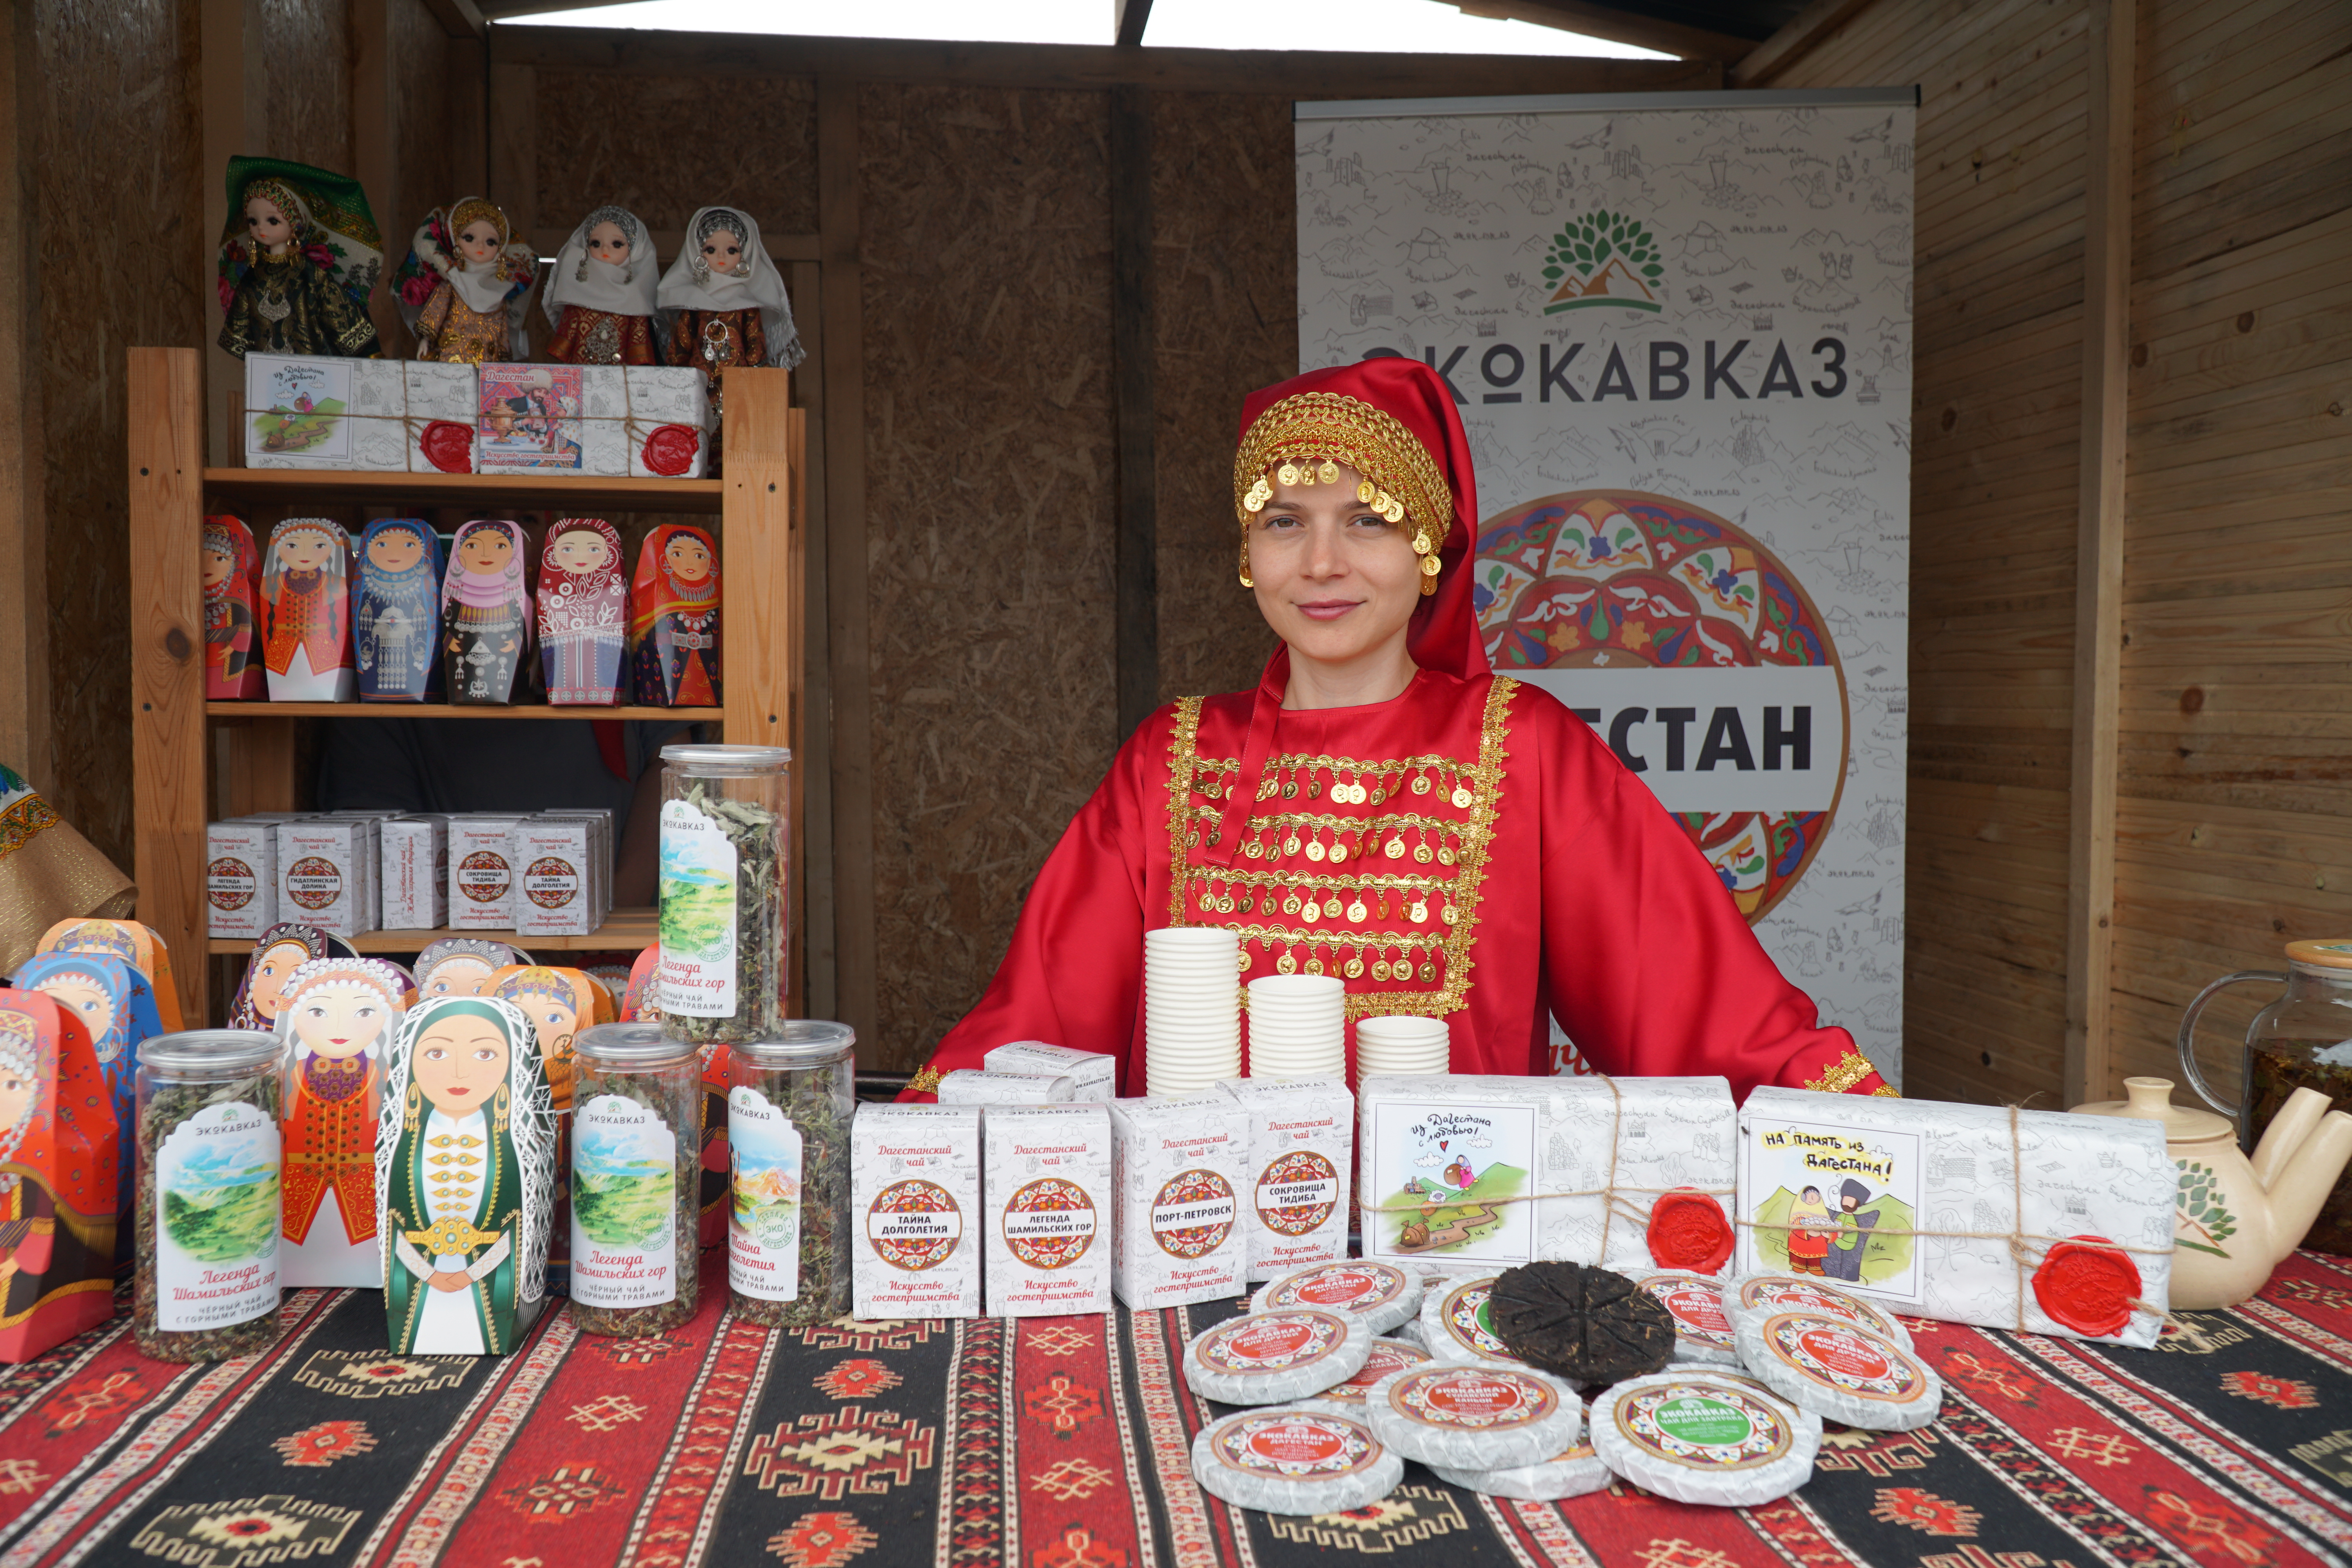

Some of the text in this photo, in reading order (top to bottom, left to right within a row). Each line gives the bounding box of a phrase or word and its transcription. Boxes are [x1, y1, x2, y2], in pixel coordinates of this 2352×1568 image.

[284, 365, 324, 375] Дагестана
[486, 371, 534, 381] Дагестан
[1362, 337, 1848, 405] КОКАВКАЗ
[284, 373, 316, 384] любовью!
[485, 451, 576, 462] Искусство гостеприимства
[1581, 706, 1811, 772] СТАН
[662, 819, 705, 831] ЭКОКАВКАЗ
[662, 956, 701, 978] Легенда
[659, 973, 725, 993] амильских гор
[682, 1002, 723, 1010] ТРАВАМИ
[1015, 1047, 1072, 1059] ЭКОКАВКАЗ
[1075, 1076, 1110, 1089] WW.KAVKAZTEA.RU
[1254, 1081, 1327, 1092] ЭКОКАВКАЗ
[1146, 1099, 1220, 1111] ЭКОКАВКАЗ
[730, 1103, 770, 1121] ЭКОКАВКАЗ
[588, 1114, 645, 1125] ЭКОКАВКАЗ
[1268, 1117, 1333, 1131] Дагестанский
[1411, 1113, 1491, 1136] из Дагестана
[195, 1119, 262, 1136] ЭКОКАВКАЗ
[1427, 1124, 1479, 1142] любовью!
[1162, 1132, 1228, 1150] Дагестанский
[1293, 1130, 1309, 1140] чай
[1765, 1133, 1785, 1146] НА
[1793, 1135, 1842, 1149] ПАМЯТЬ
[878, 1145, 952, 1155] Дагестанский
[1014, 1143, 1087, 1155] Дагестанский
[1187, 1148, 1204, 1157] чай
[906, 1157, 925, 1167] чай
[1042, 1156, 1060, 1165] чай
[1270, 1183, 1325, 1196] СОКРОВИЩА
[1279, 1194, 1316, 1205] ТИДИБА
[898, 1215, 931, 1224] ТАЙНА
[1029, 1215, 1070, 1223] ЛЕГЕНДА
[1155, 1205, 1232, 1223] ПОРТ-ПЕТРОВСК
[766, 1224, 783, 1233] ЭКО
[881, 1225, 948, 1235] ДОЛГОЛЕТИЯ
[1007, 1223, 1091, 1234] ШАМИЛЬСКИХ ГОР
[731, 1233, 761, 1255] Тайна
[762, 1232, 792, 1247] ДАГЕСТАНЕ
[1273, 1243, 1321, 1257] Искусство
[590, 1250, 644, 1271] Легенда
[729, 1248, 776, 1271] олголетия
[1256, 1252, 1334, 1269] гостеприимства
[199, 1264, 261, 1285] Легенда
[575, 1260, 666, 1281] Шамильских гор
[1171, 1266, 1219, 1281] Искусство
[750, 1274, 764, 1283] ЧАЙ
[1154, 1275, 1232, 1294] гостеприимства
[1304, 1278, 1366, 1292] ЭКОКАВКАЗ
[173, 1270, 276, 1301] Шамильских гор
[589, 1284, 645, 1293] ЧЁРНЫЙ ЧАЙ
[747, 1281, 784, 1292] ТРАВАМИ
[889, 1280, 943, 1294] Искусство
[1024, 1279, 1078, 1292] Искусство
[1314, 1284, 1356, 1294] ДАГЕСТАН
[580, 1290, 618, 1300] ГОРНЫМИ
[622, 1289, 665, 1301] ТРАВАМИ
[872, 1292, 960, 1305] гостеприимства
[1007, 1290, 1094, 1304] гостеприимства
[185, 1310, 236, 1323] ГОРНЫМИ
[240, 1295, 275, 1316] ТРАВАМИ
[199, 1294, 262, 1314] ЧЁРНЫЙ ЧАЙ
[1671, 1299, 1722, 1310] ЭКОКАВК
[1236, 1326, 1302, 1344] ЭКОКАВКАЗ
[1243, 1332, 1299, 1348] ДЛЯ ДРУЗЕЙ
[1807, 1334, 1880, 1361] ЭКОКАВКАЗ
[1813, 1342, 1875, 1365] ДЛЯ ДРУЗЕЙ
[1659, 1408, 1736, 1419] ЭКОКАВКАЗ
[1259, 1432, 1334, 1441] ЭКОКАВКАЗ
